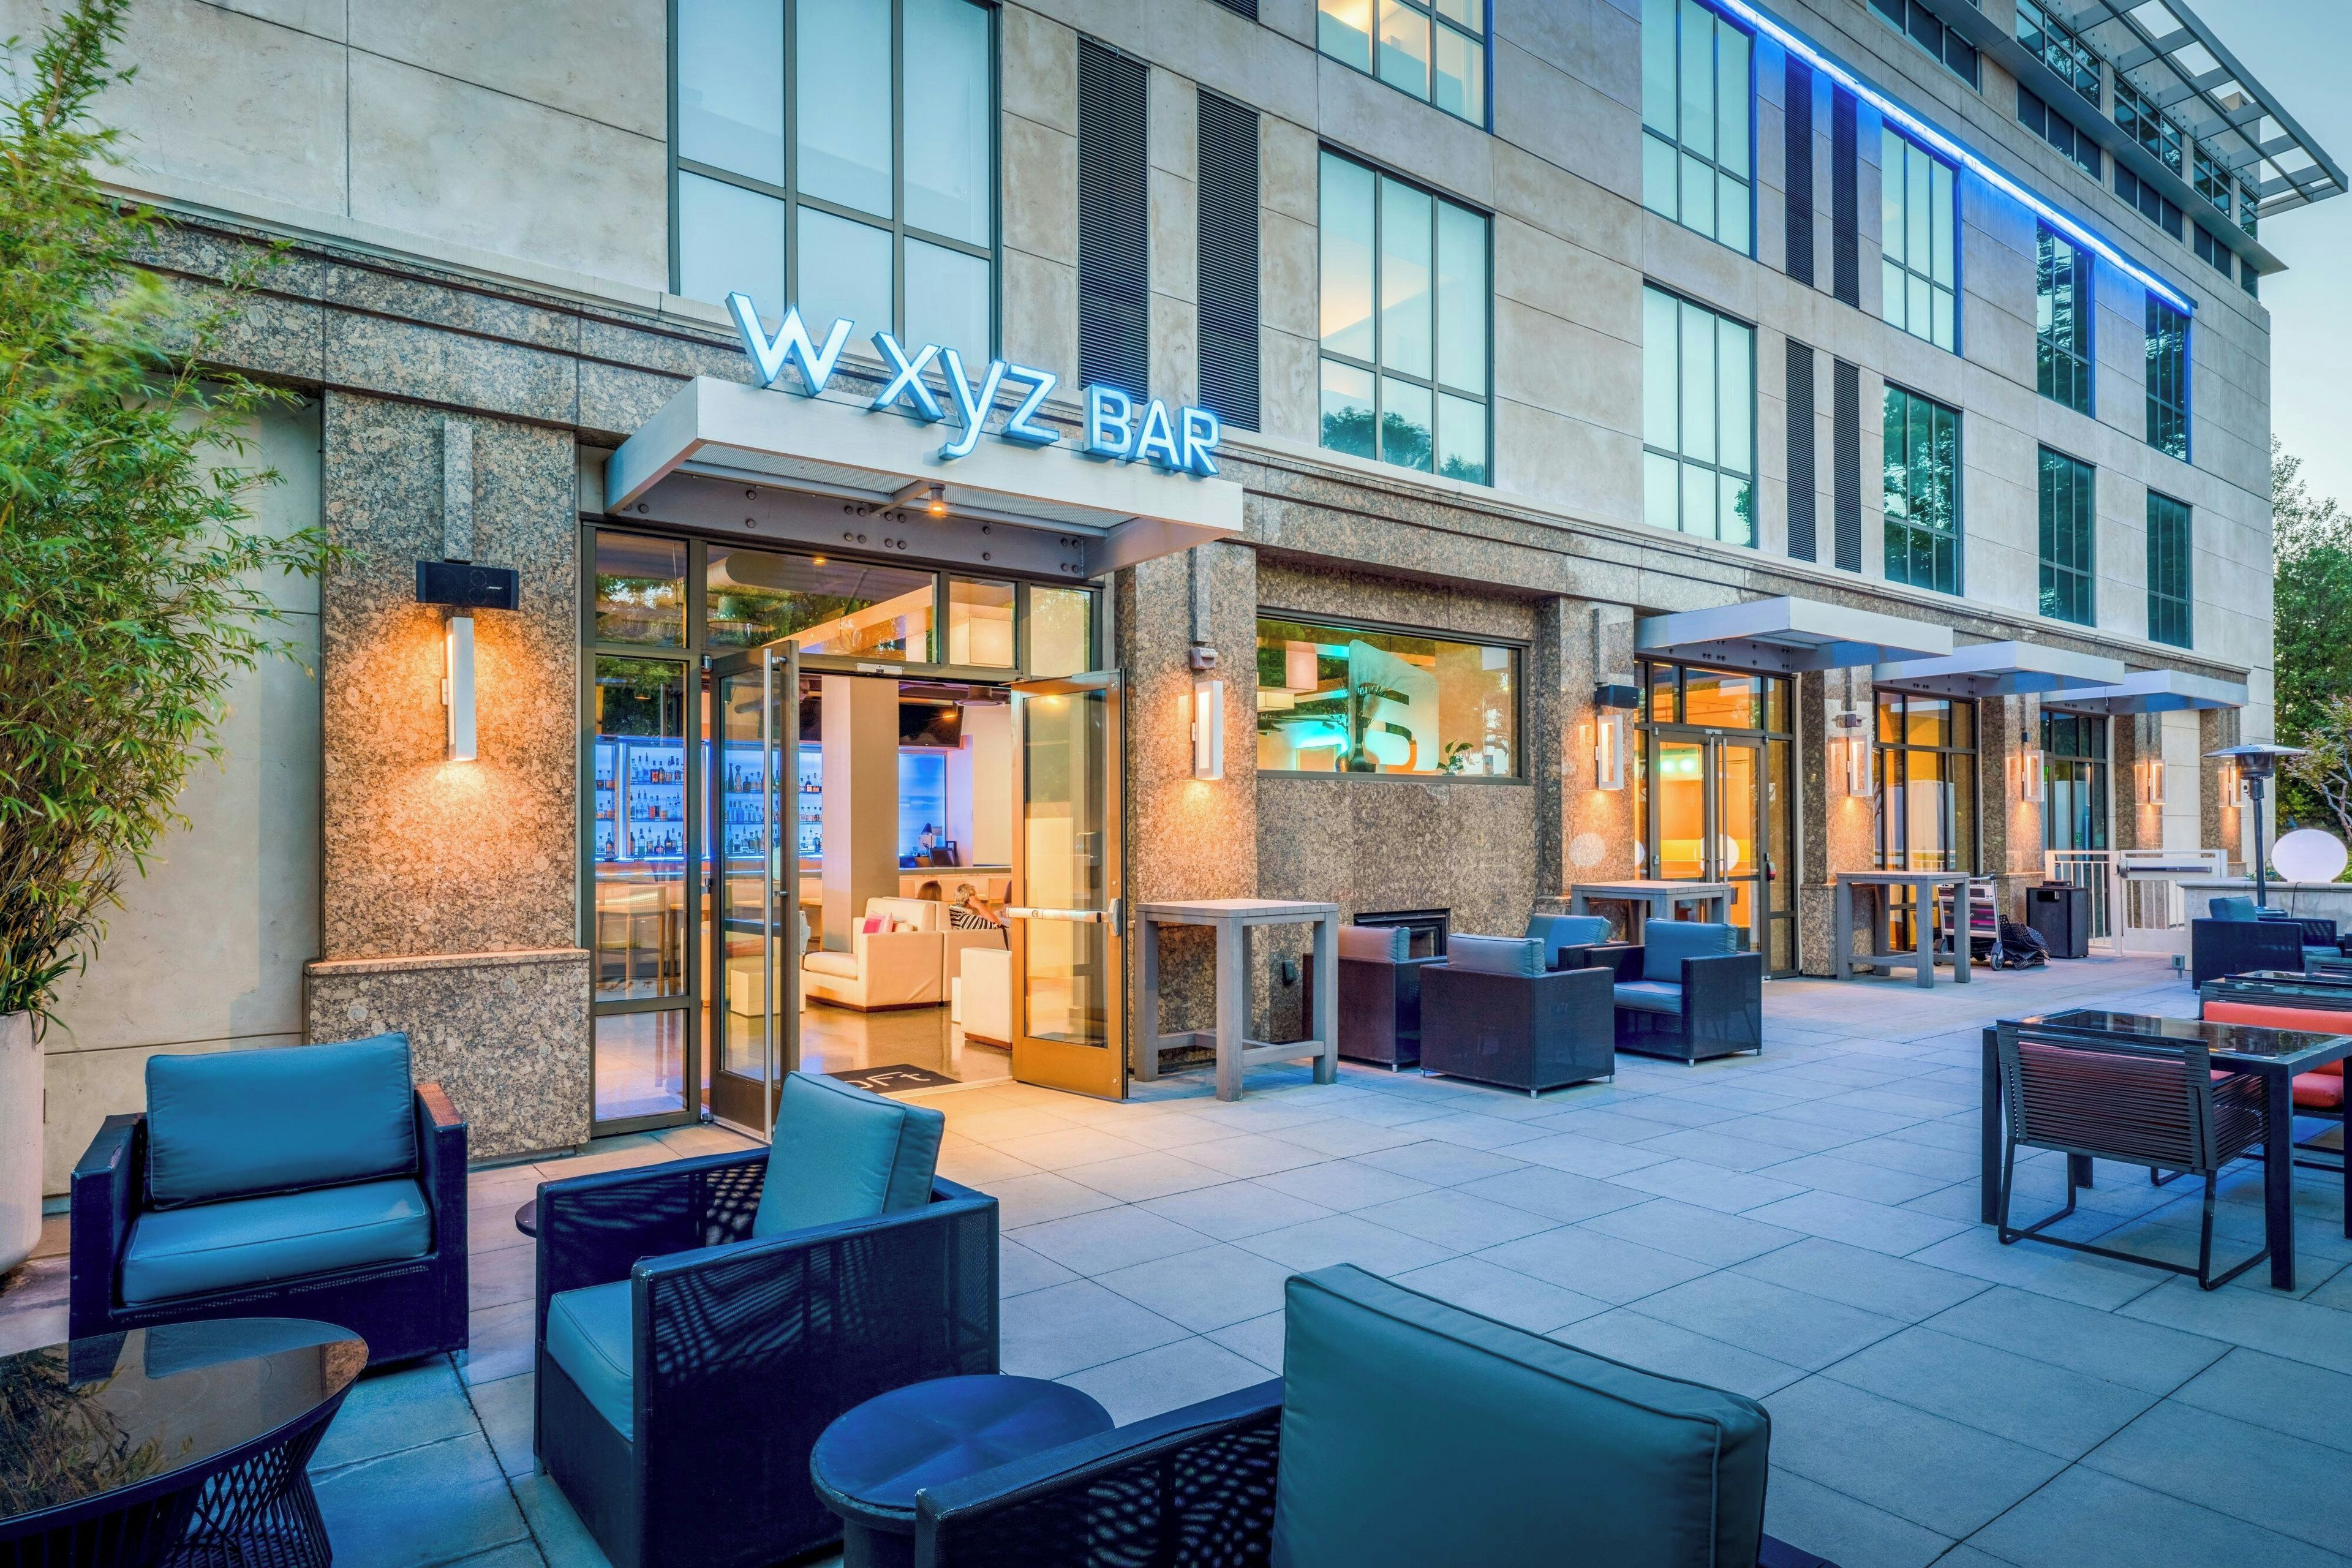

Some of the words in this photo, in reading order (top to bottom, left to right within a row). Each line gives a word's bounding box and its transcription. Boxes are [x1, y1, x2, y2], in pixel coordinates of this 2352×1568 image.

[725, 290, 855, 398] W
[868, 331, 1060, 461] xyz
[1082, 383, 1220, 477] BAR
